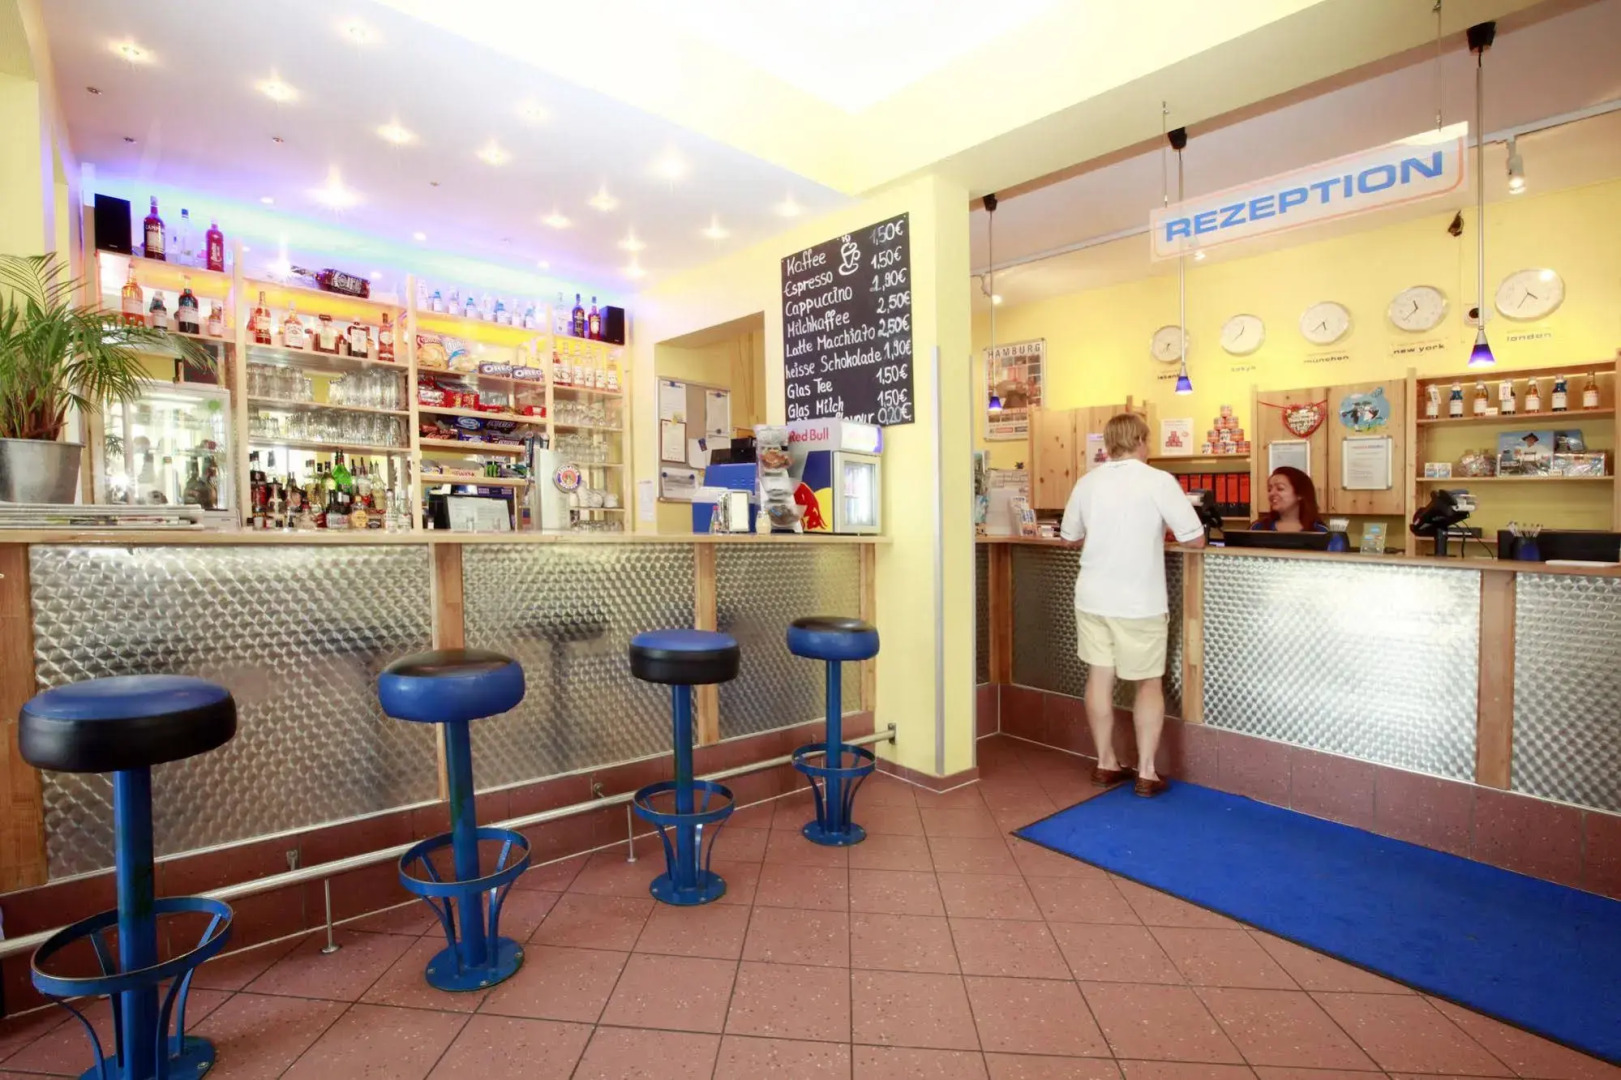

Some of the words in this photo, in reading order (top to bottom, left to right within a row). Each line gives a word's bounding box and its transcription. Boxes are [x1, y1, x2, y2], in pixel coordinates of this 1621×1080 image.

[1166, 151, 1443, 242] REZEPTION
[786, 249, 826, 276] Kaffee
[870, 220, 904, 245] 1,50€
[784, 271, 833, 297] Espresso
[871, 246, 902, 269] 1,50€
[785, 286, 853, 316] Cappuccino
[787, 309, 850, 338] Milchkaffee
[876, 291, 911, 314] 2,50€
[786, 338, 813, 357] Latte
[817, 324, 875, 350] Macchiato
[877, 313, 910, 338] 2,50€
[987, 343, 1041, 358] HAMBURG
[1418, 344, 1444, 352] york
[483, 363, 512, 374] OREO
[514, 368, 542, 378] OREO
[785, 362, 815, 379] heisse
[820, 347, 882, 373] Schokolade
[787, 383, 811, 399] Glas
[813, 377, 833, 393] Tee
[876, 363, 908, 384] 1,50€
[787, 403, 810, 419] Glas
[816, 395, 844, 415] Milch
[877, 388, 908, 408] 1,50€
[877, 402, 912, 425] 0,20€
[788, 429, 807, 442] Red
[810, 427, 829, 441] Bull
